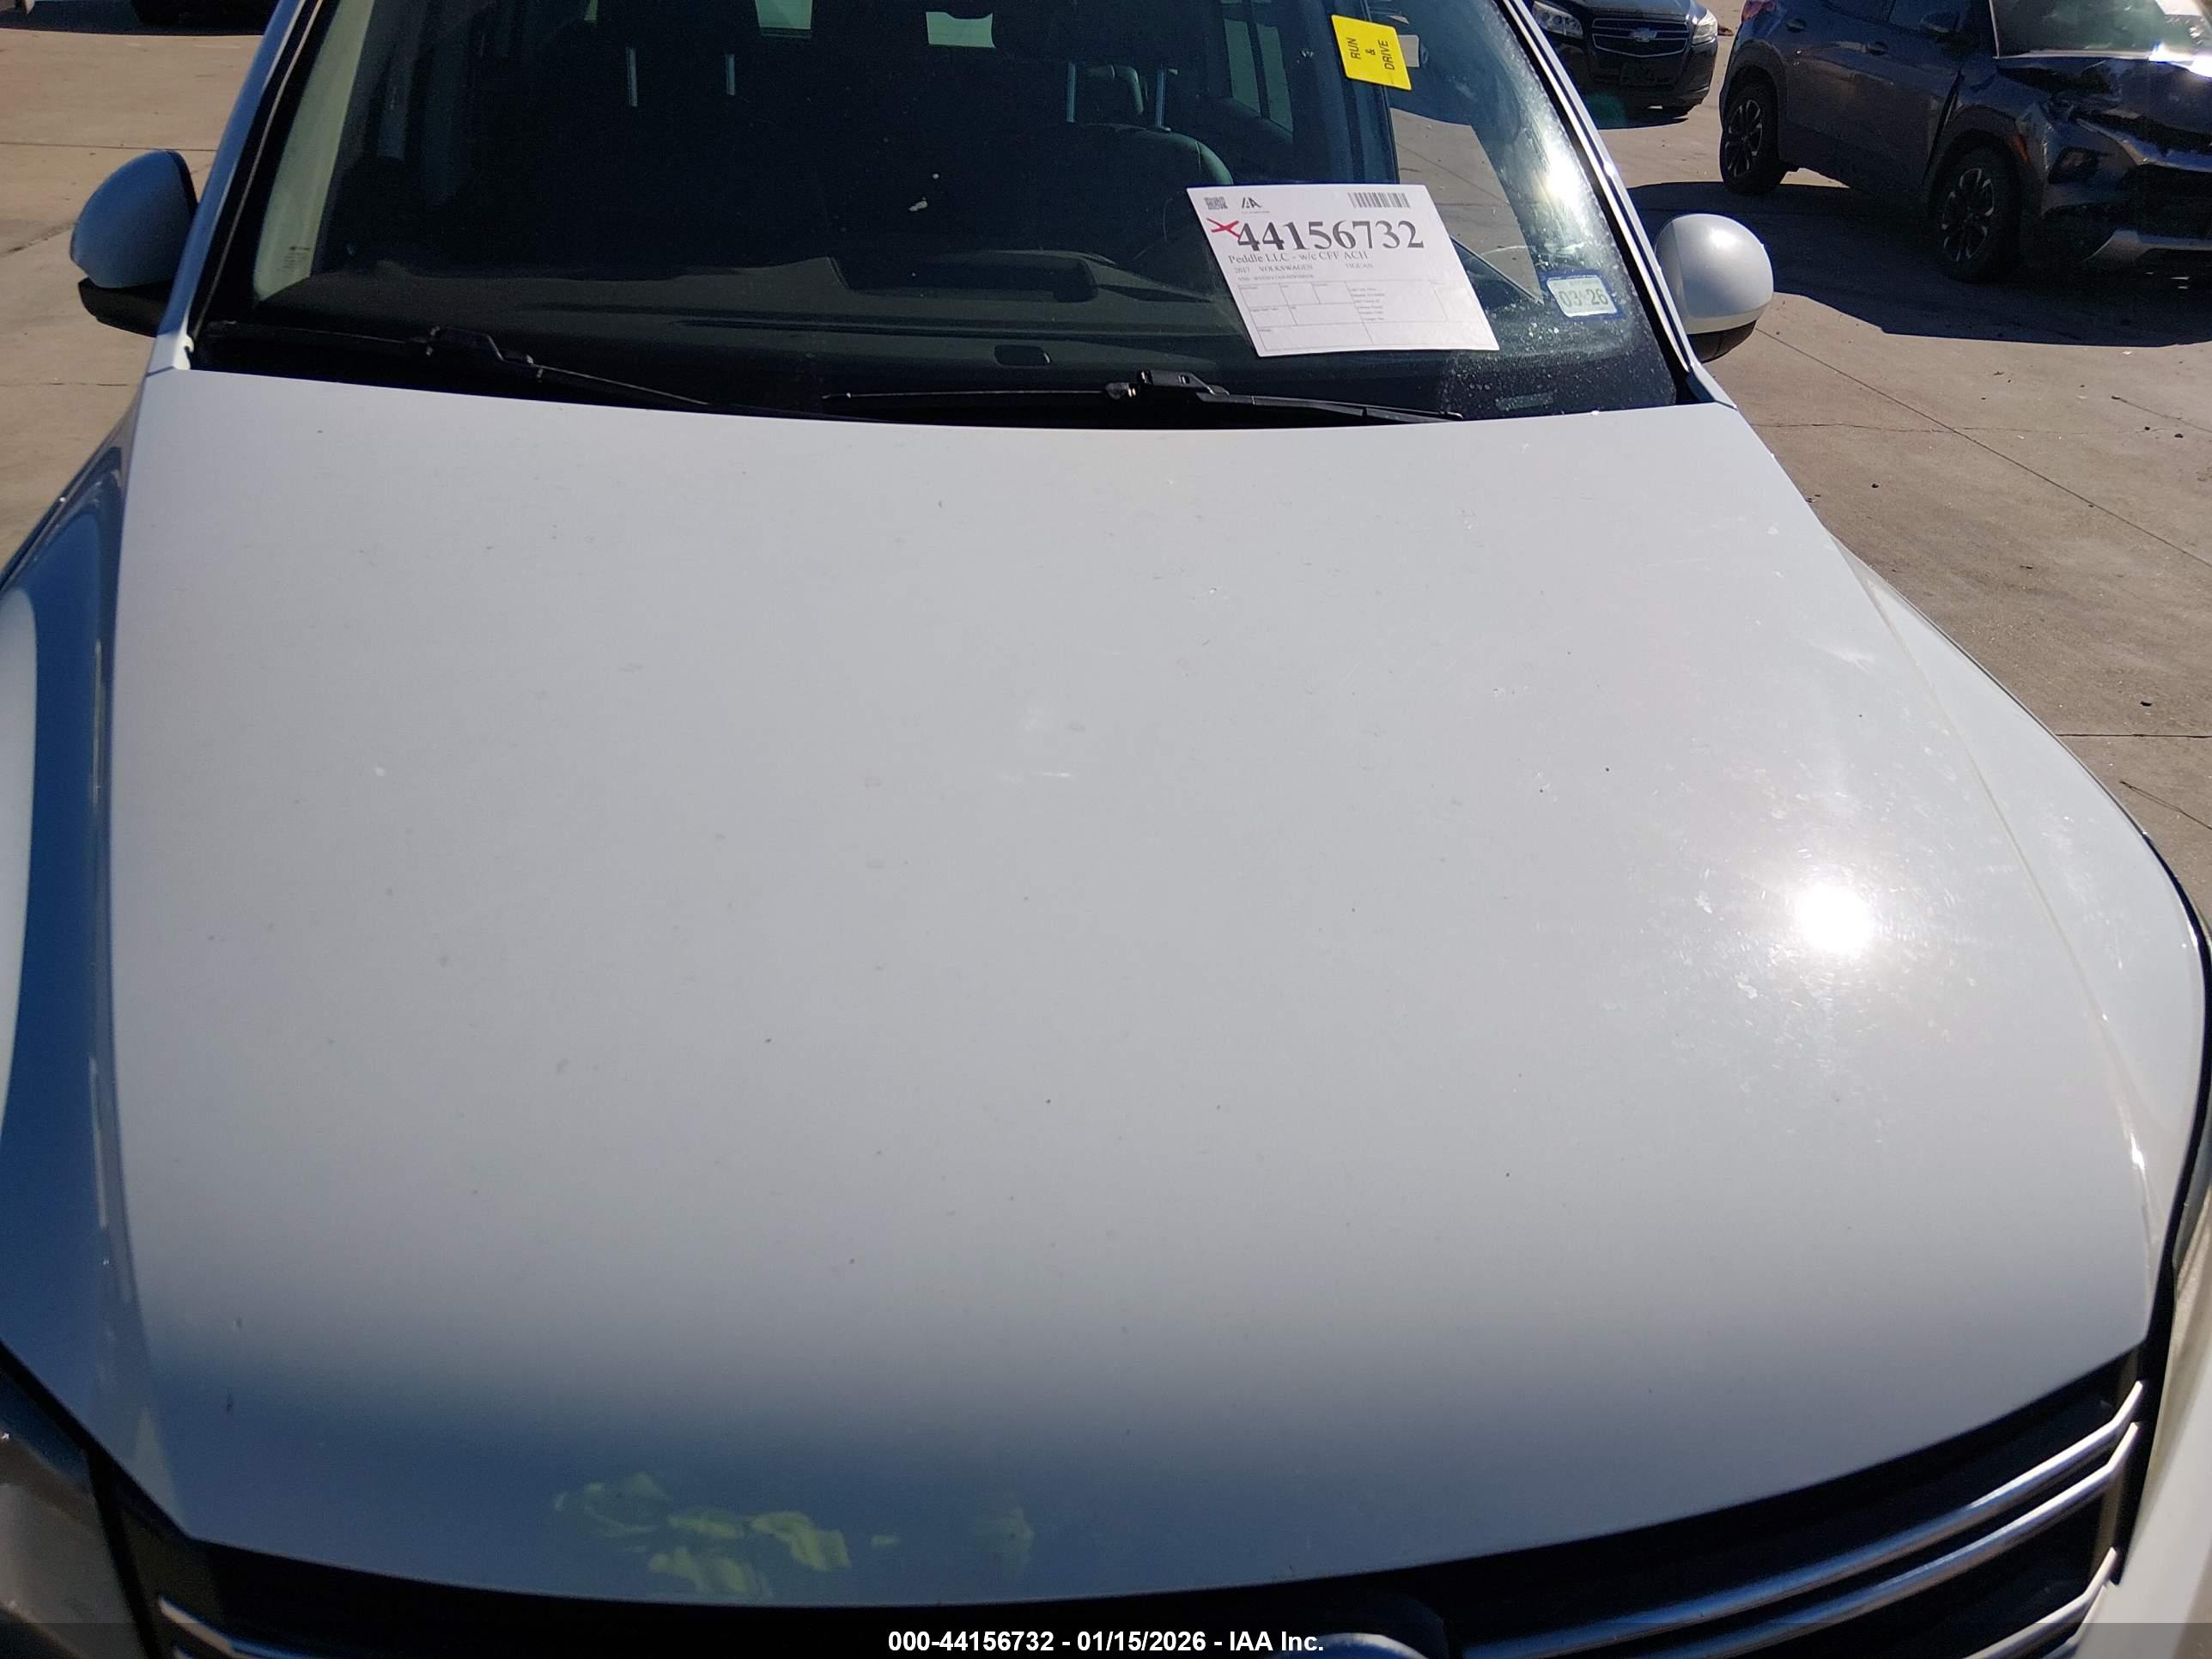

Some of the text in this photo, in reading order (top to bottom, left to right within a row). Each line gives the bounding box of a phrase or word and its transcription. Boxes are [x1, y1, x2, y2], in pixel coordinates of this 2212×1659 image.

[1346, 37, 1361, 60] RUN
[1365, 47, 1376, 56] &
[1378, 39, 1395, 70] DRIVE
[1237, 219, 1425, 252] 44156732
[1228, 253, 1264, 264] Peddle
[1267, 252, 1289, 262] LLC
[1258, 264, 1314, 273] VOLKSWAGEN
[1585, 287, 1609, 306] 26
